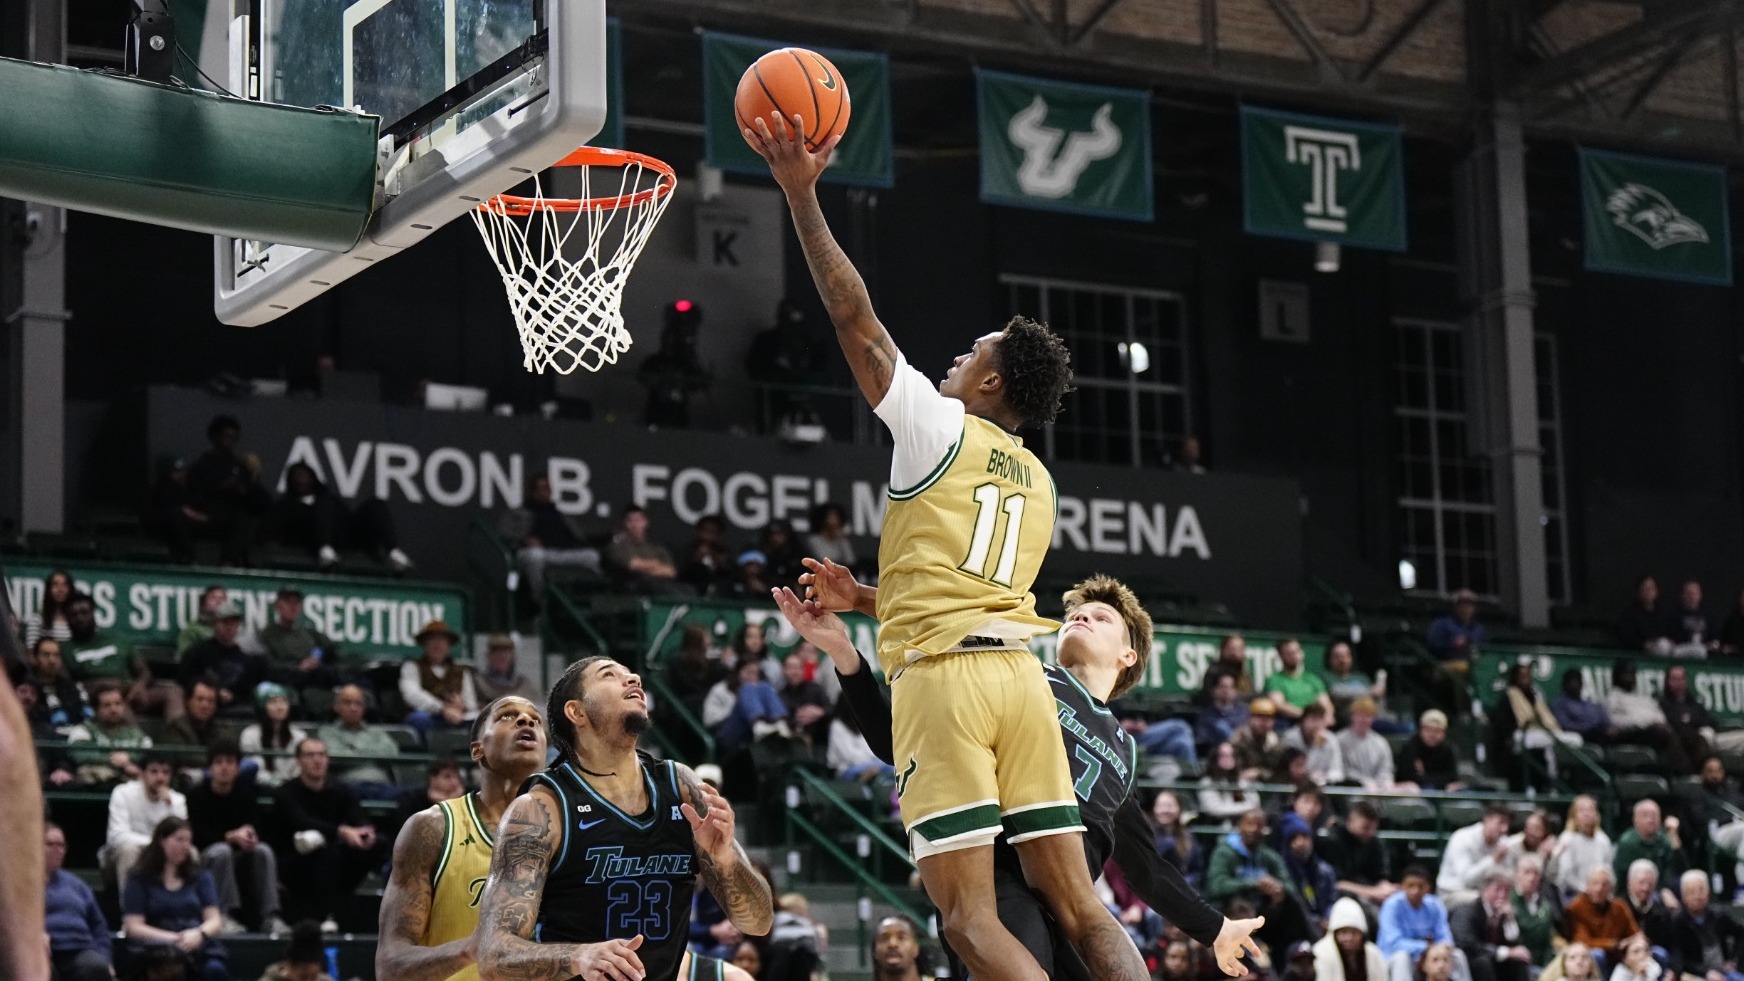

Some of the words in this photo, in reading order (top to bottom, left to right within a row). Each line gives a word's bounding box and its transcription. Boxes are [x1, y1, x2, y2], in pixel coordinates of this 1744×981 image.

[713, 230, 740, 266] K
[986, 448, 1024, 487] BROWN
[276, 436, 524, 508] AVRON
[548, 457, 610, 517] B.
[1052, 496, 1212, 560] RENA
[957, 481, 1027, 589] 11
[1074, 743, 1102, 802] 7
[585, 845, 692, 884] TULANE
[606, 879, 673, 941] 23
